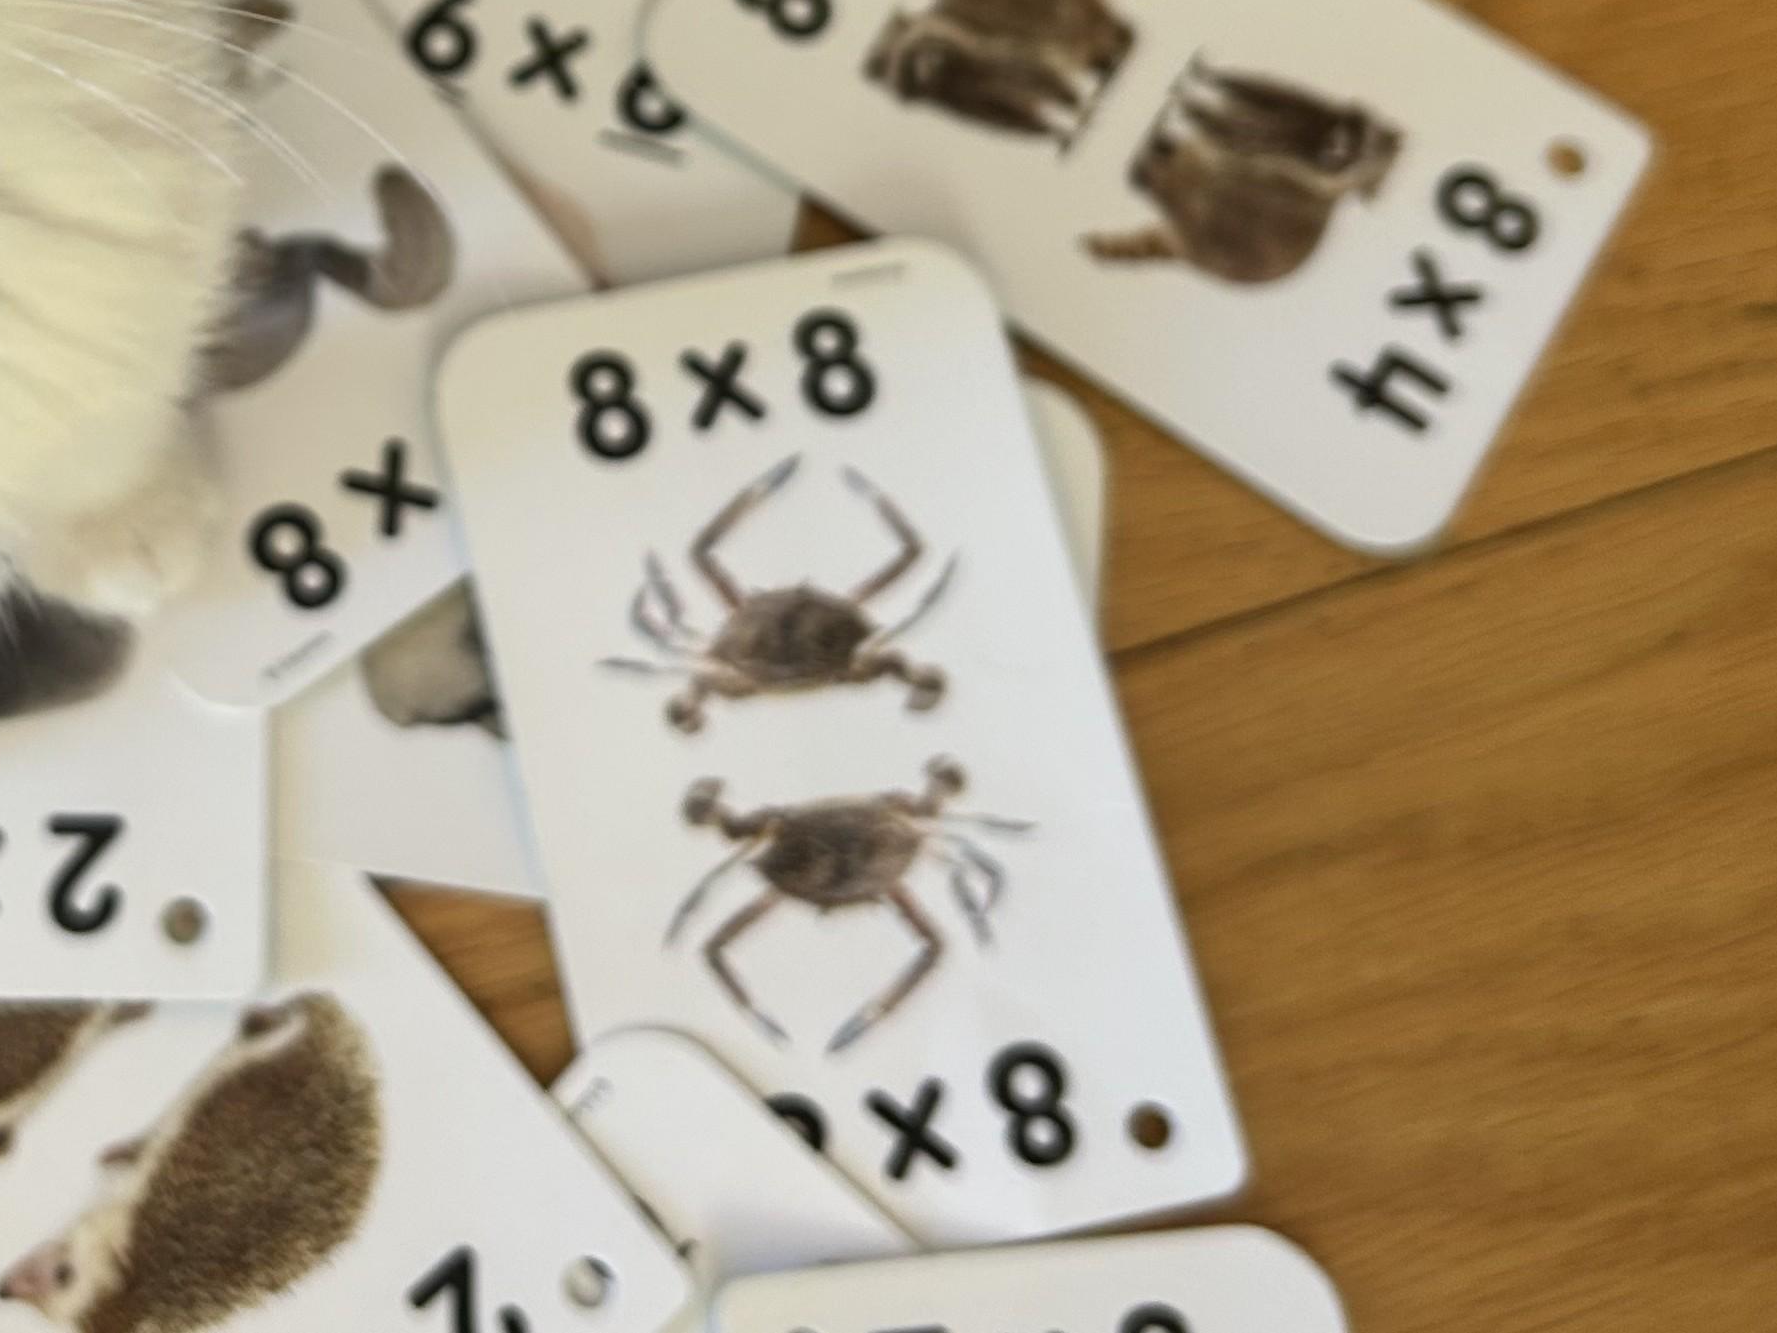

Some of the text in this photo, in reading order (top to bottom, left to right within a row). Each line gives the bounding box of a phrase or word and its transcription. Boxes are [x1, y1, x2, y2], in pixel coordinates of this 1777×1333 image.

[509, 19, 589, 102] x
[1331, 166, 1541, 433] 8 x 4
[570, 310, 877, 463] 8 x 8
[246, 439, 440, 611] x 8
[47, 815, 123, 936] 2
[866, 1079, 957, 1182] x
[987, 1043, 1078, 1169] 8
